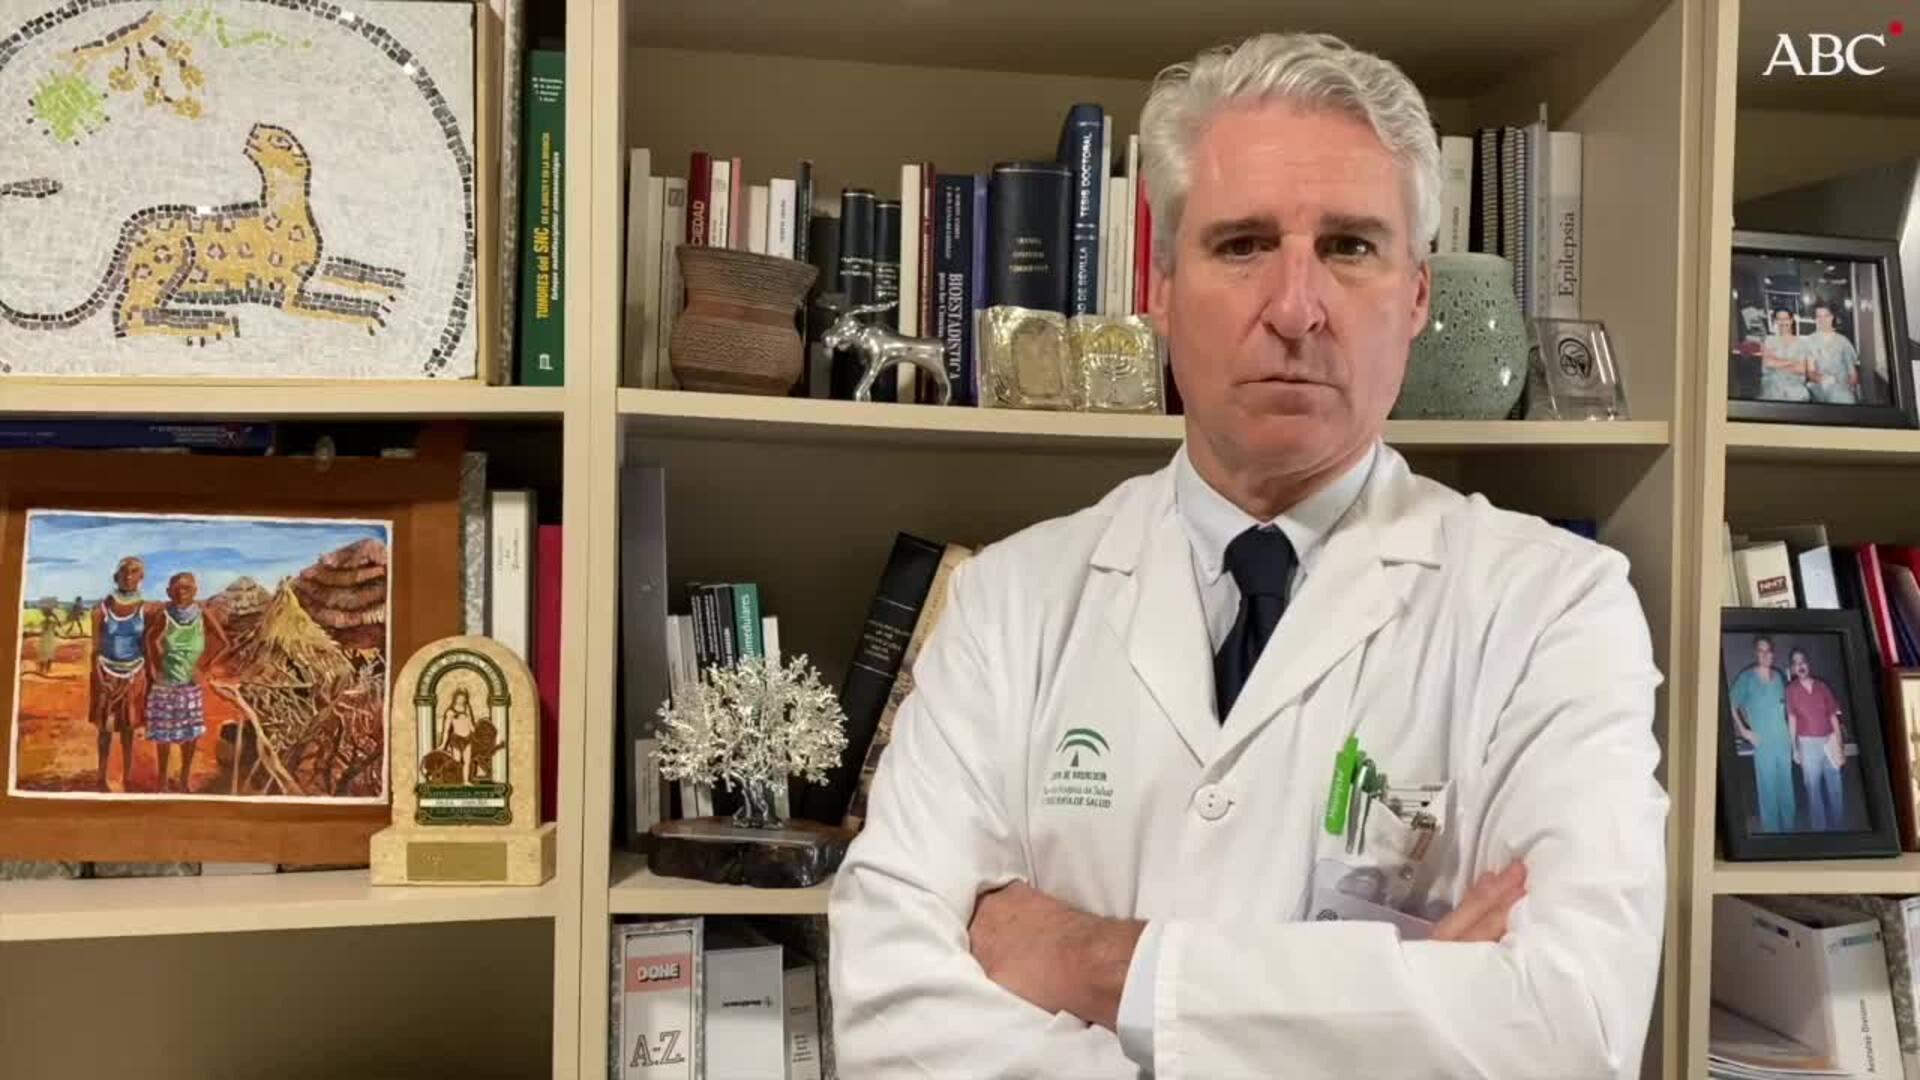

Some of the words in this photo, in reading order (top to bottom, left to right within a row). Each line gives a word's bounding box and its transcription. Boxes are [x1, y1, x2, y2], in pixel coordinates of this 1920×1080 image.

[1080, 132, 1093, 187] DOCTORAL
[1079, 189, 1091, 218] TESIS
[533, 226, 550, 254] SNC
[1557, 211, 1577, 298] Epilepsia
[1077, 247, 1088, 286] SEVILLA
[536, 273, 549, 320] TUMORES
